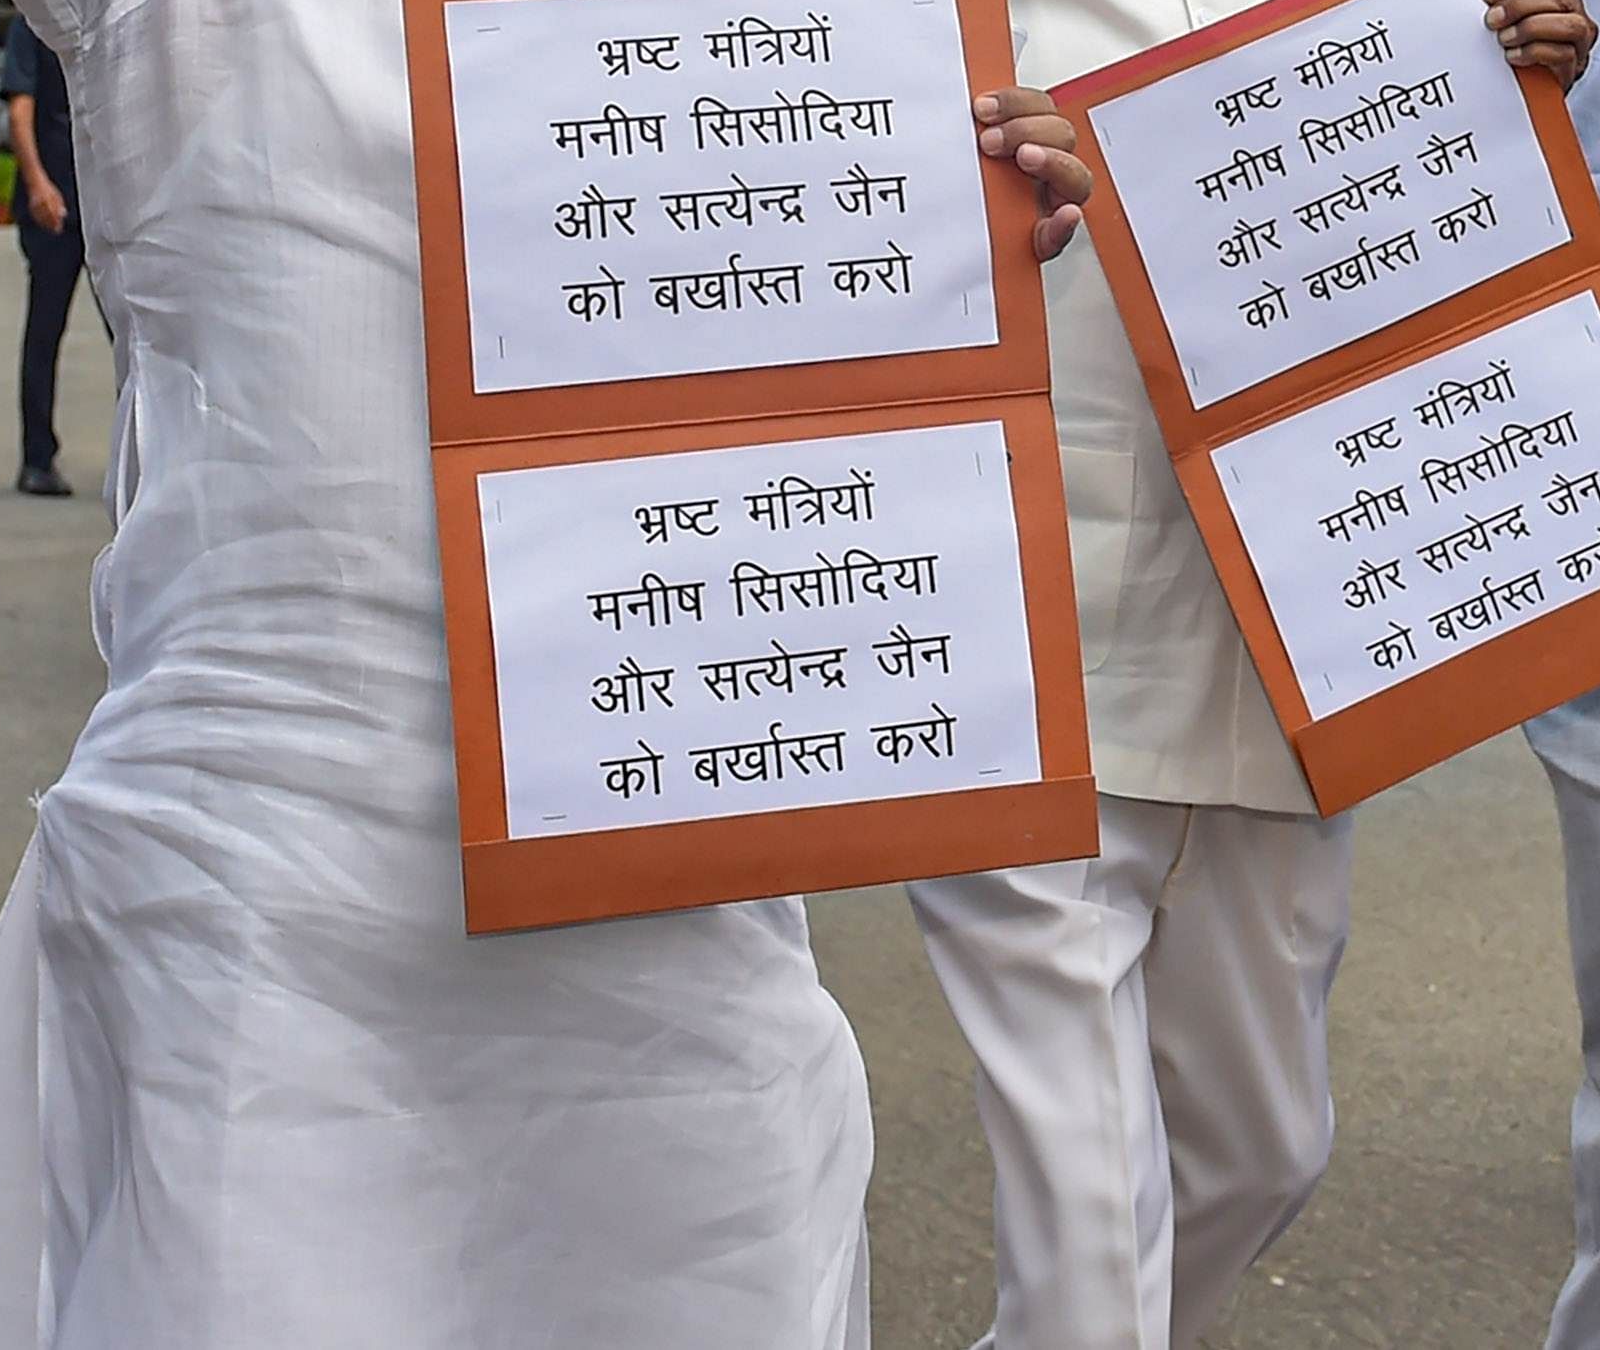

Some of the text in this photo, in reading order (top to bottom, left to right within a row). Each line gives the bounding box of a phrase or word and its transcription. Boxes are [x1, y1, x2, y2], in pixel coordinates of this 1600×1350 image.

[597, 12, 832, 76] भ्रष्ट मंत्रियों
[1214, 20, 1394, 128] भ्रष्ट मंत्रियों
[549, 89, 894, 159] मनीष सिसोदिया
[1194, 71, 1454, 202] मनीष सिसोदिया
[554, 163, 907, 240] और सत्येन्द्र जैन
[1217, 131, 1478, 268] और सत्येन्द्र जैन
[561, 240, 913, 323] को बर्खास्त करो
[1237, 187, 1497, 329] को बर्खास्त करो
[1335, 359, 1516, 468] भ्रष्ट मंत्रियों
[634, 468, 875, 544] भ्रष्ट मंत्रियों
[1317, 410, 1578, 542] मनीष सिसोदिया
[586, 548, 939, 631] मनीष सिसोदिया
[1342, 559, 1407, 609] और
[1415, 504, 1531, 574] सत्येन्द्र
[591, 623, 951, 714] और सत्येन्द्र जैन
[1365, 621, 1417, 670] को
[1427, 569, 1545, 641] बर्खास्त
[599, 702, 957, 799] को बर्खास्त करो
